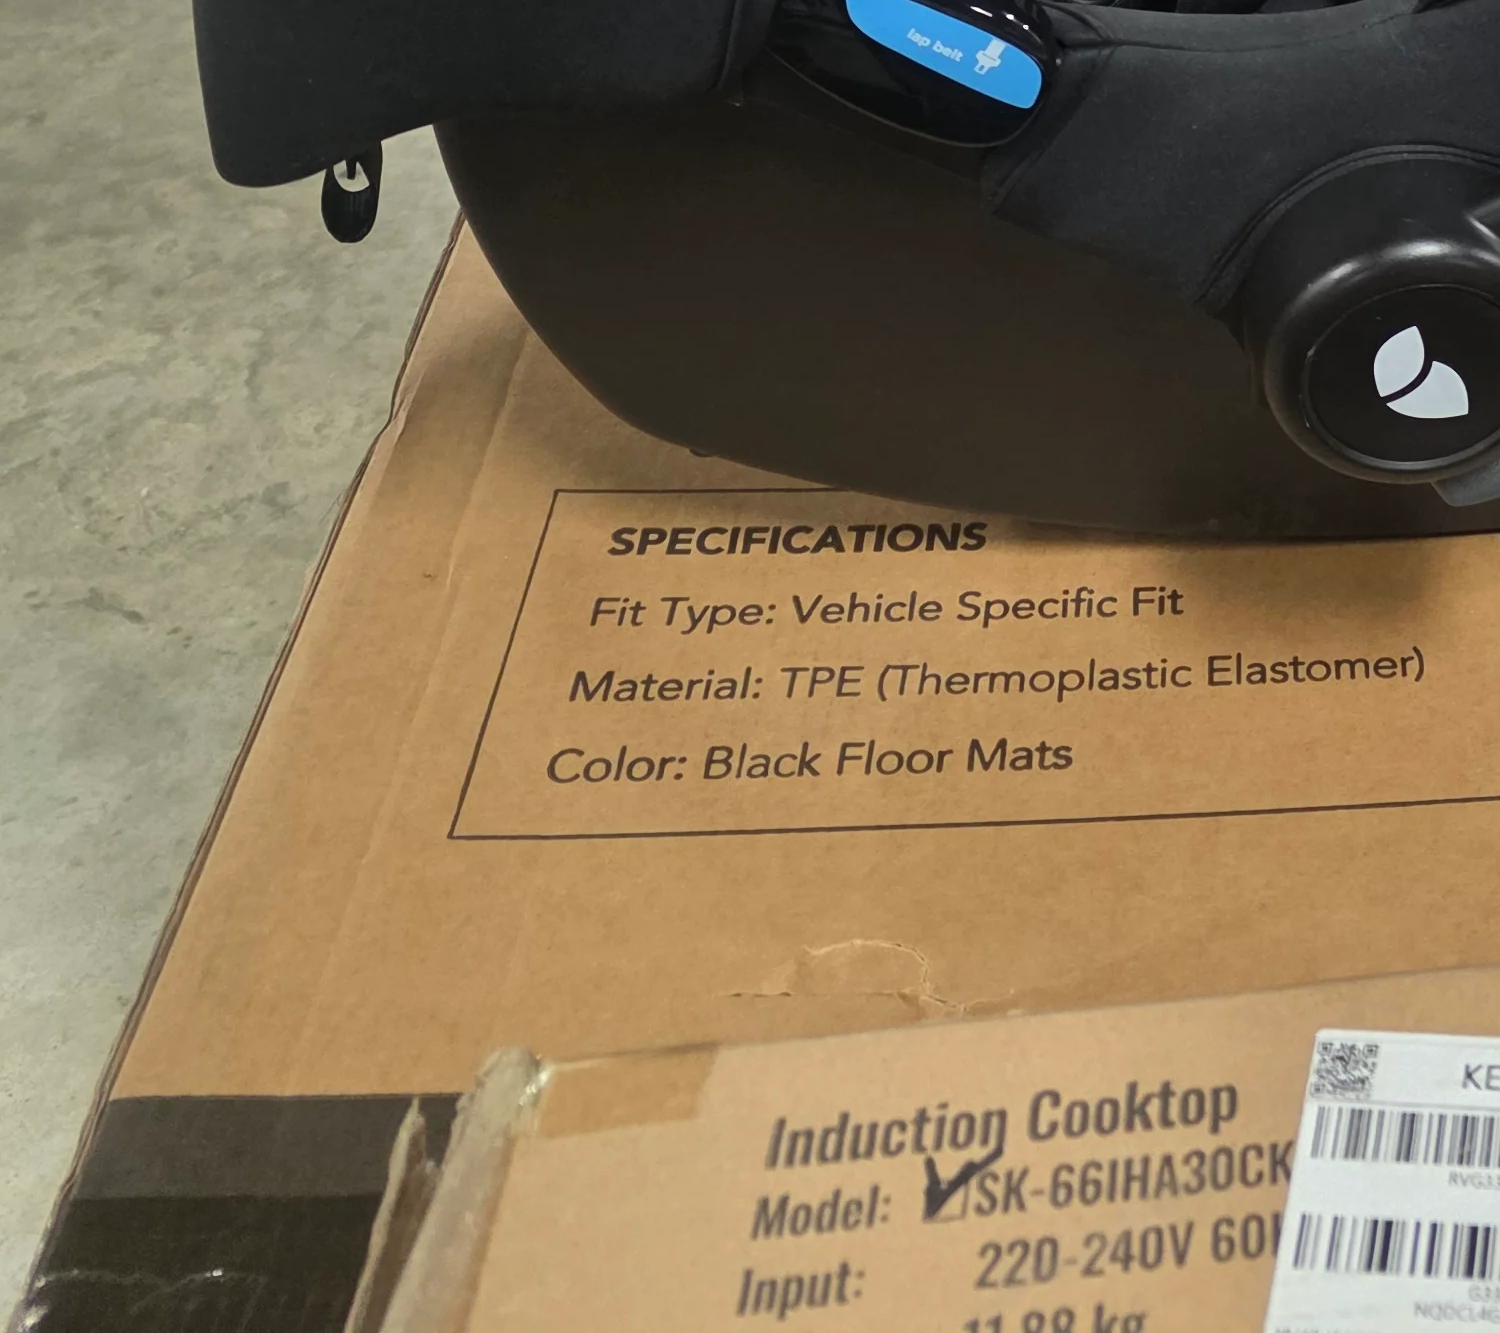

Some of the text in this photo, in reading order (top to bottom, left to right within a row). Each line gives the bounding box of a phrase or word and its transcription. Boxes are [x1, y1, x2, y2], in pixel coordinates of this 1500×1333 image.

[906, 27, 964, 63] lap belt
[608, 522, 988, 557] SPECIFICATIONS
[590, 586, 1185, 635] Fit Type: Vehicle Specific Fit
[568, 645, 1425, 703] Material: TPE (Thermoplastic Elastomer)
[546, 738, 1074, 784] Color: Black Floor Mats
[764, 1080, 1239, 1171] Induction Cooktop
[750, 1183, 893, 1242] Model:
[735, 1261, 866, 1321] Input:
[974, 1219, 1195, 1291] 220-240V
